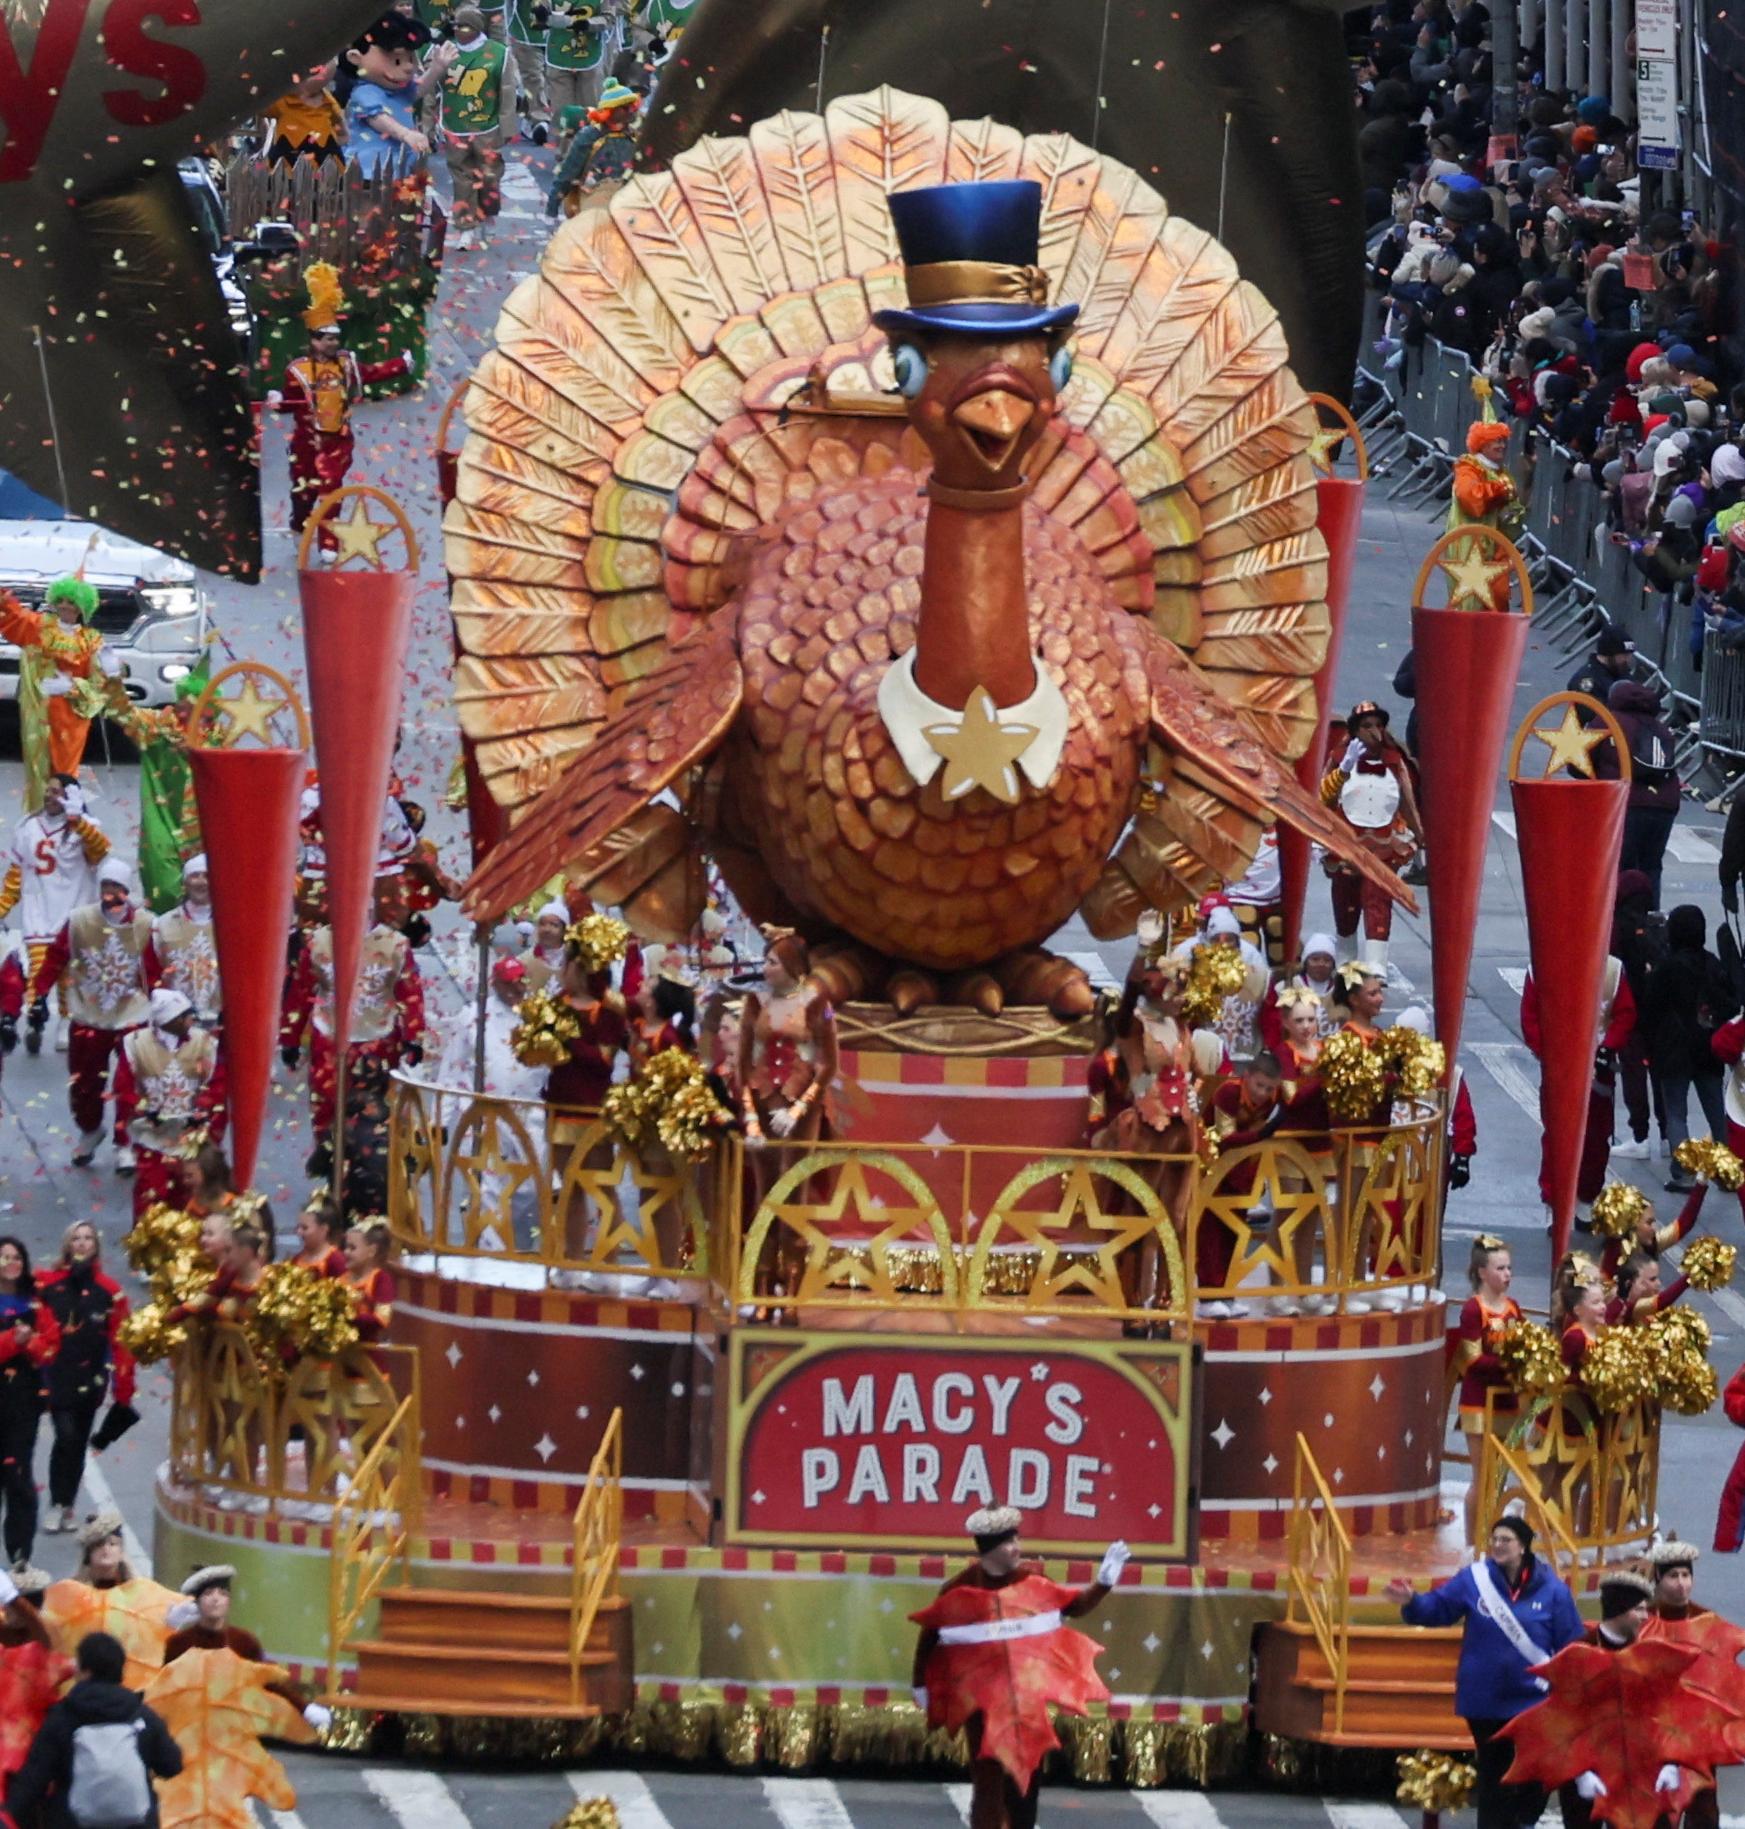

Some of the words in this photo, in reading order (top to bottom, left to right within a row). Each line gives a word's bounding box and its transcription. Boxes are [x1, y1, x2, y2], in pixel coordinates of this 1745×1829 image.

[1640, 61, 1648, 81] 5
[35, 840, 56, 875] S
[802, 1443, 1100, 1518] PARADE
